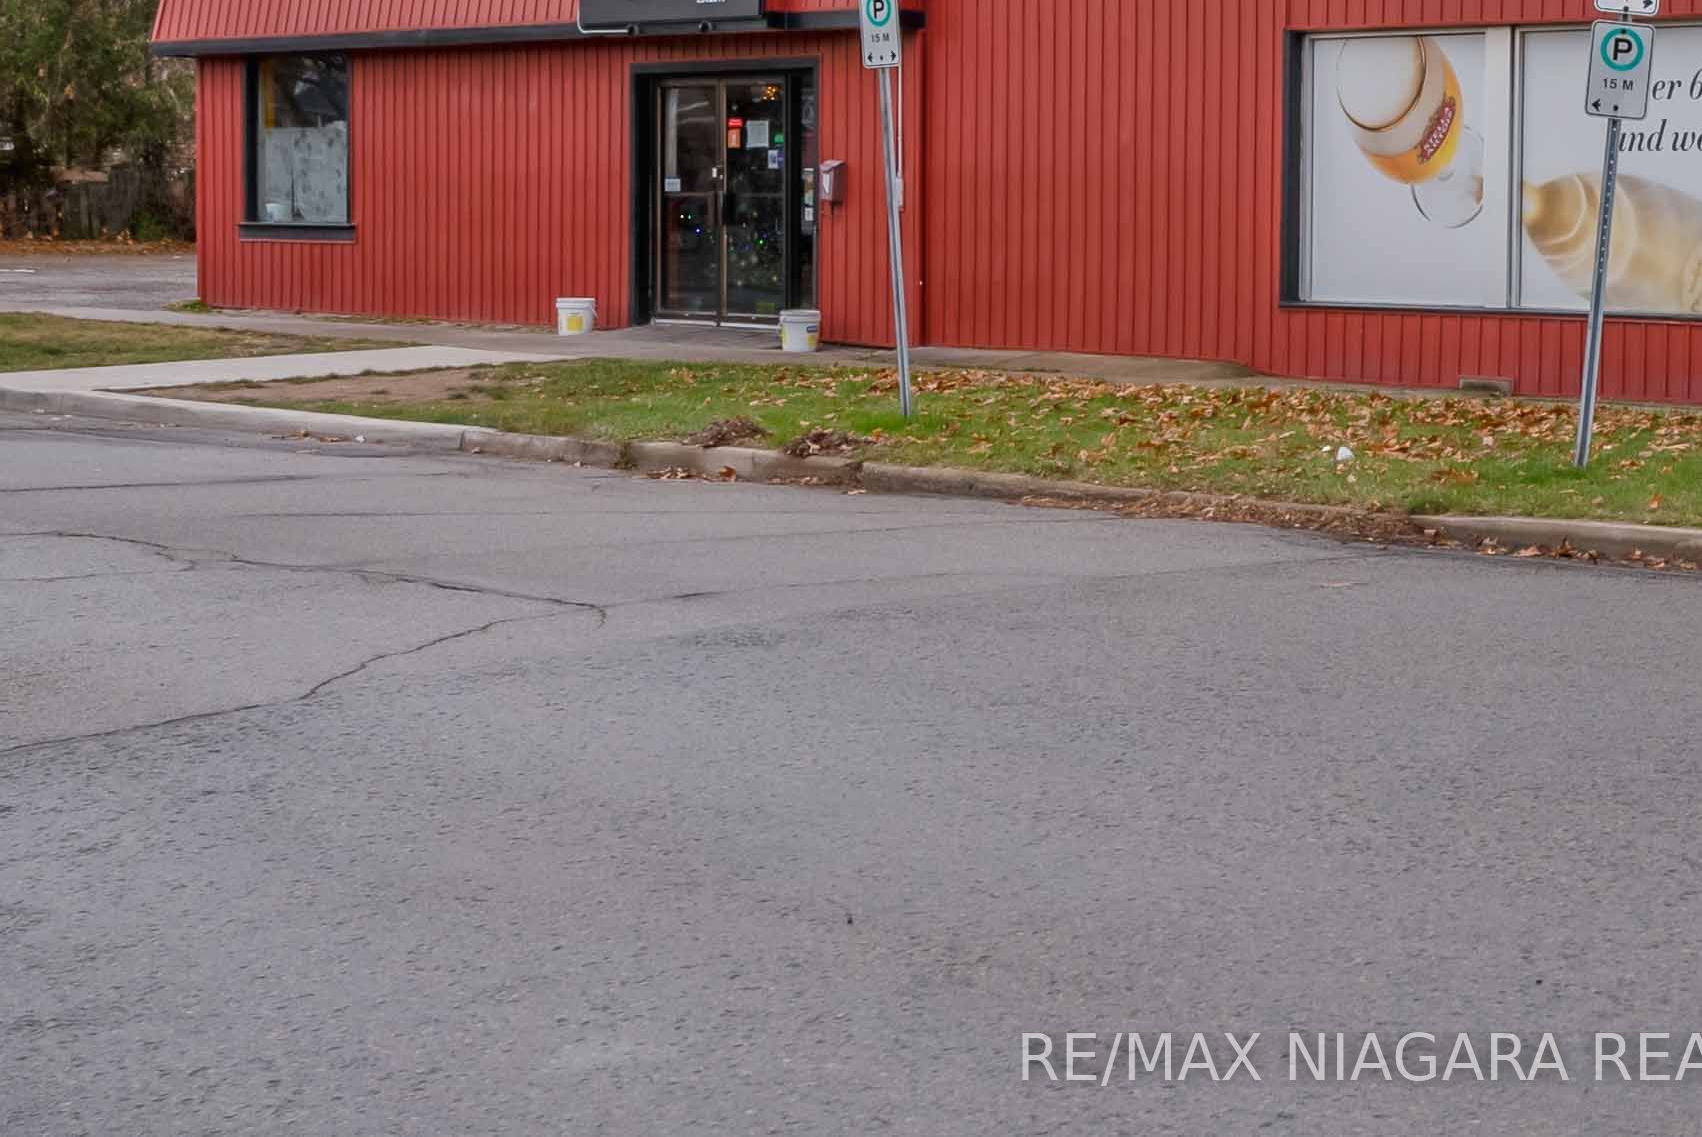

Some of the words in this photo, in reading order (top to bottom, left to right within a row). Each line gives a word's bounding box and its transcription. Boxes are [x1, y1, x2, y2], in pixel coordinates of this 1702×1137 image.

[873, 0, 884, 19] P
[1613, 38, 1632, 61] P
[1602, 78, 1617, 90] 15
[1622, 80, 1634, 91] M
